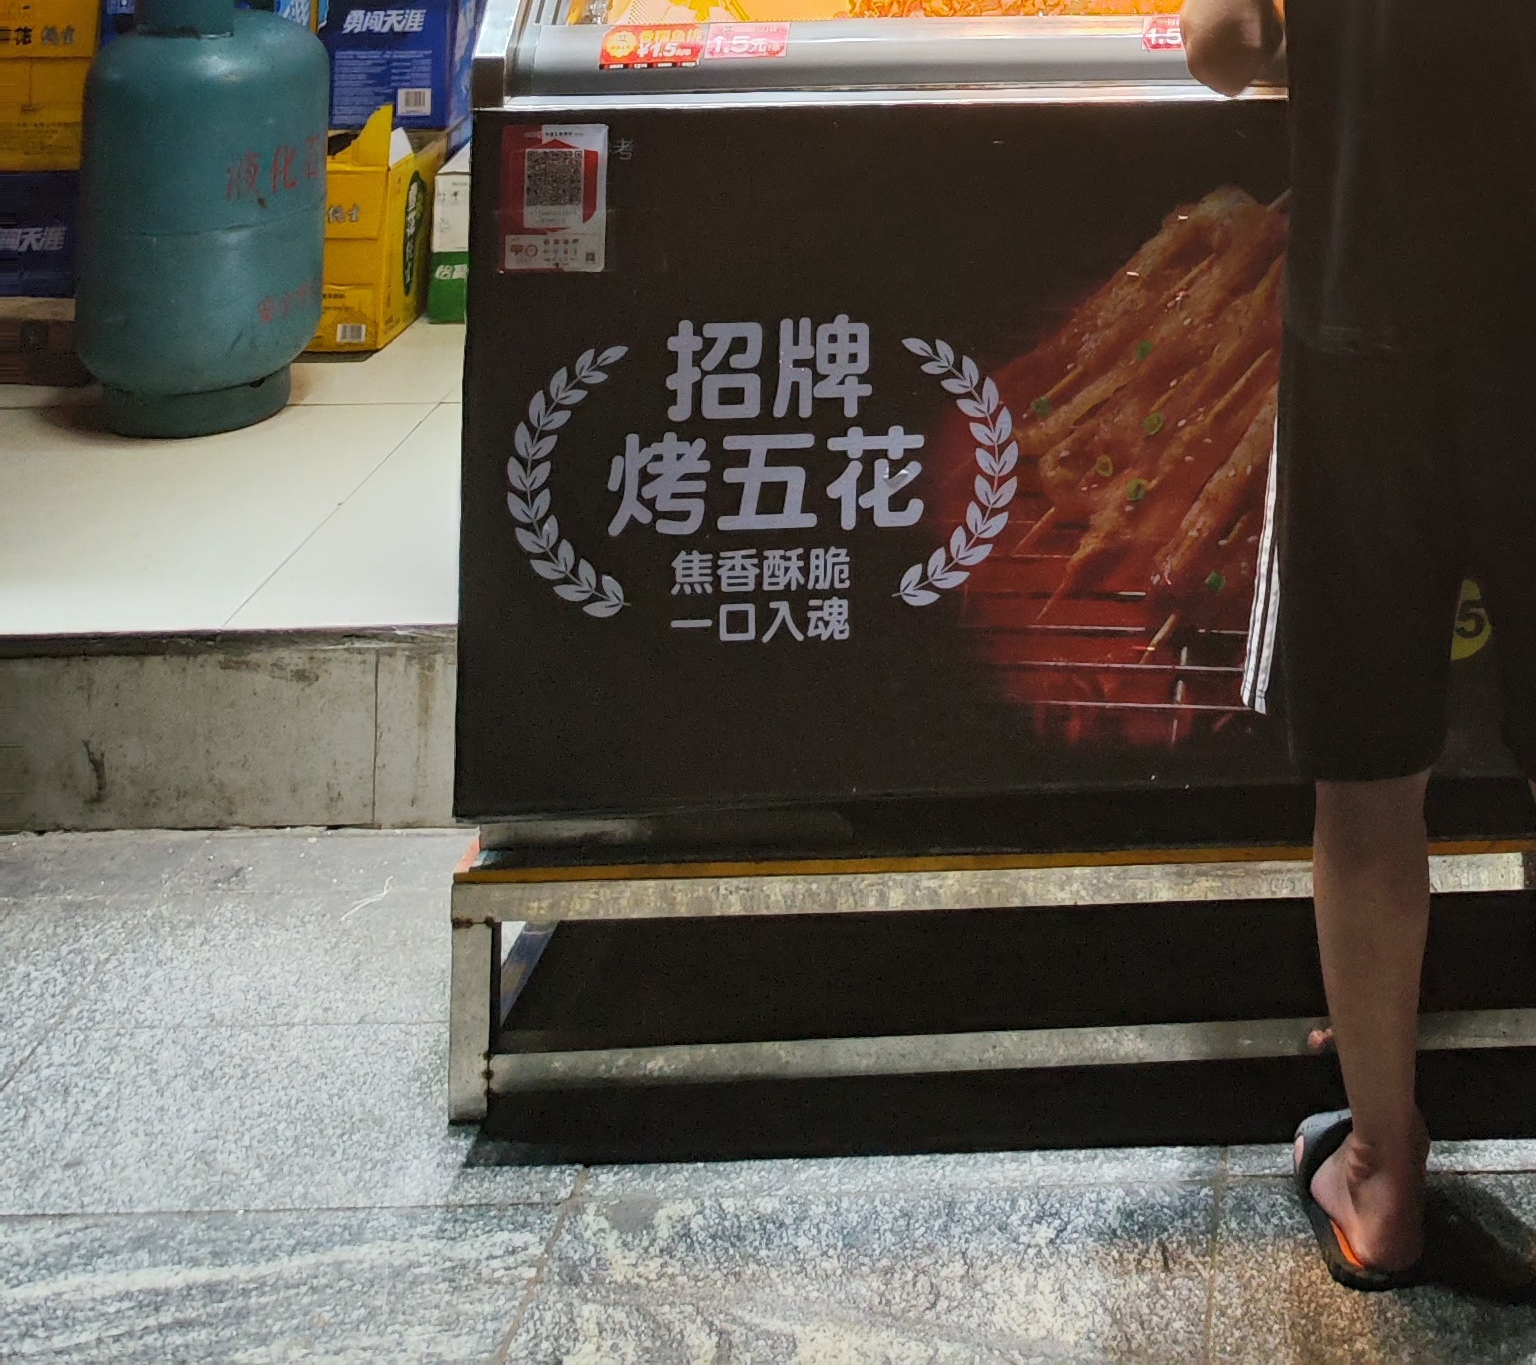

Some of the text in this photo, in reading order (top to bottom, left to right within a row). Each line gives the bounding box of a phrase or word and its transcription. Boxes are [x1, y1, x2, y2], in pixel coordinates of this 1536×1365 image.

[342, 9, 426, 34] 勇闯天涯
[666, 314, 872, 423] 招牌
[606, 426, 926, 537] 烤五花
[670, 548, 851, 597] 焦香酥脆
[670, 598, 850, 643] 一口入魂
